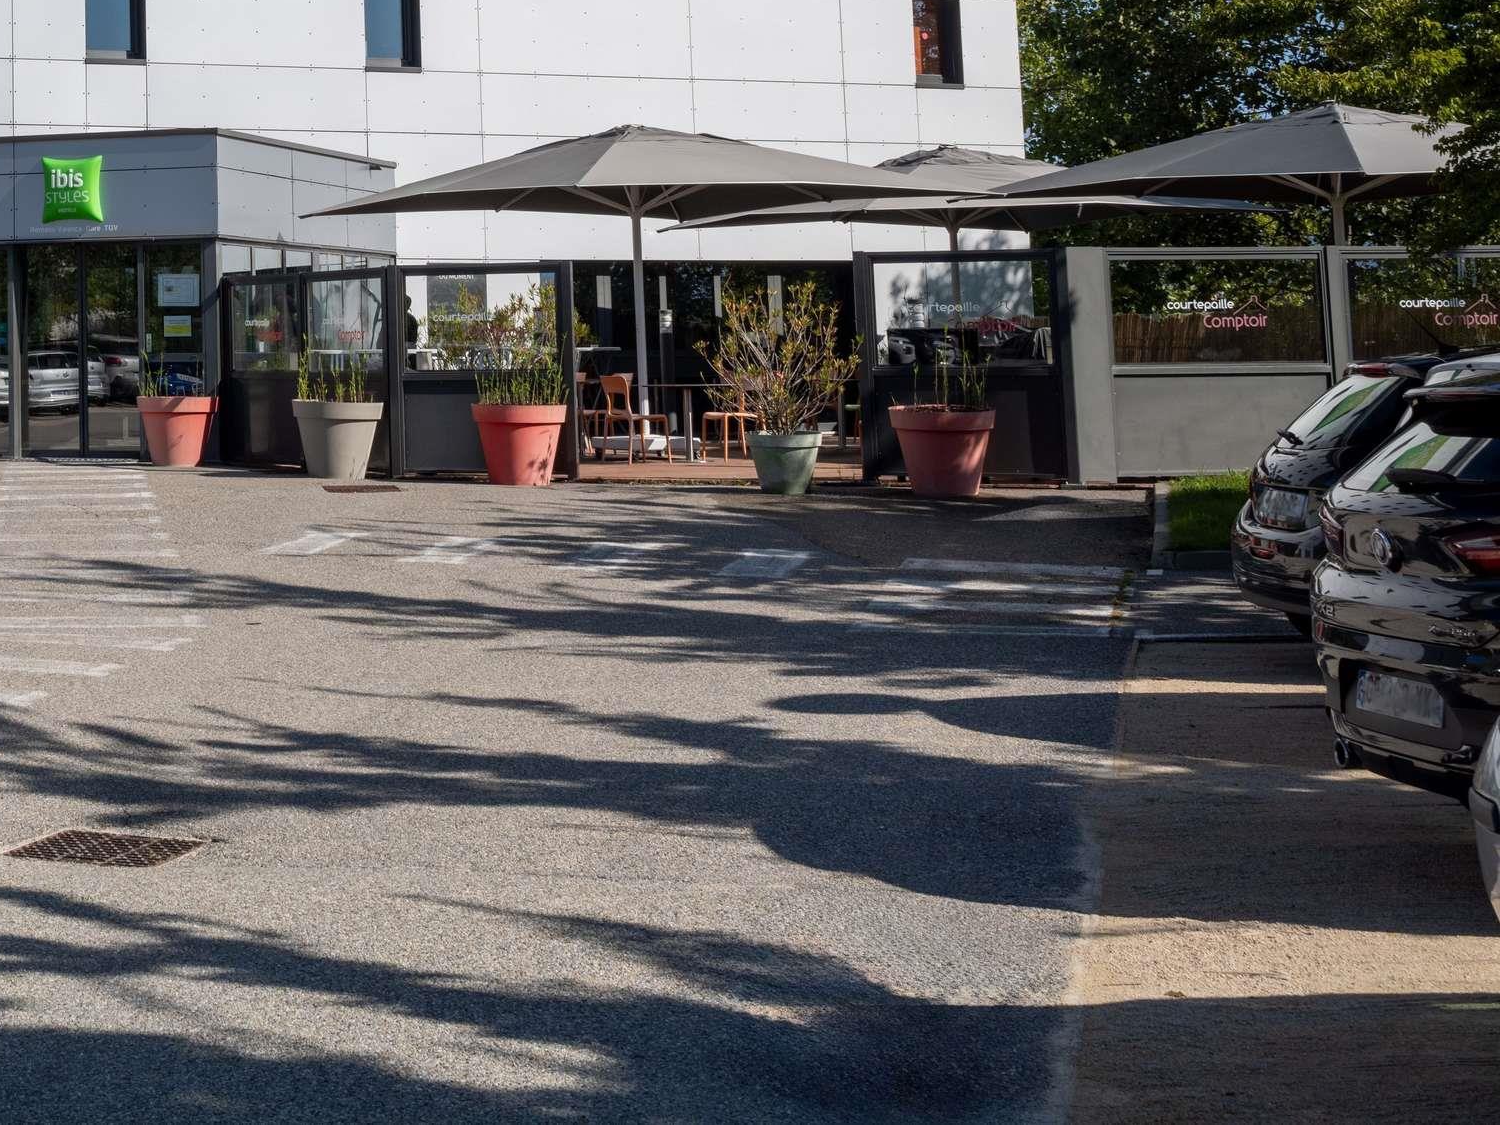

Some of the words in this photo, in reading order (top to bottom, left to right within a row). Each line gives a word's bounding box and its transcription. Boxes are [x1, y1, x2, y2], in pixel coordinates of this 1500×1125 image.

[51, 168, 84, 188] ibis
[1167, 299, 1234, 311] courtepaille
[1399, 297, 1466, 310] courtepaille
[1203, 314, 1268, 331] Comptoir
